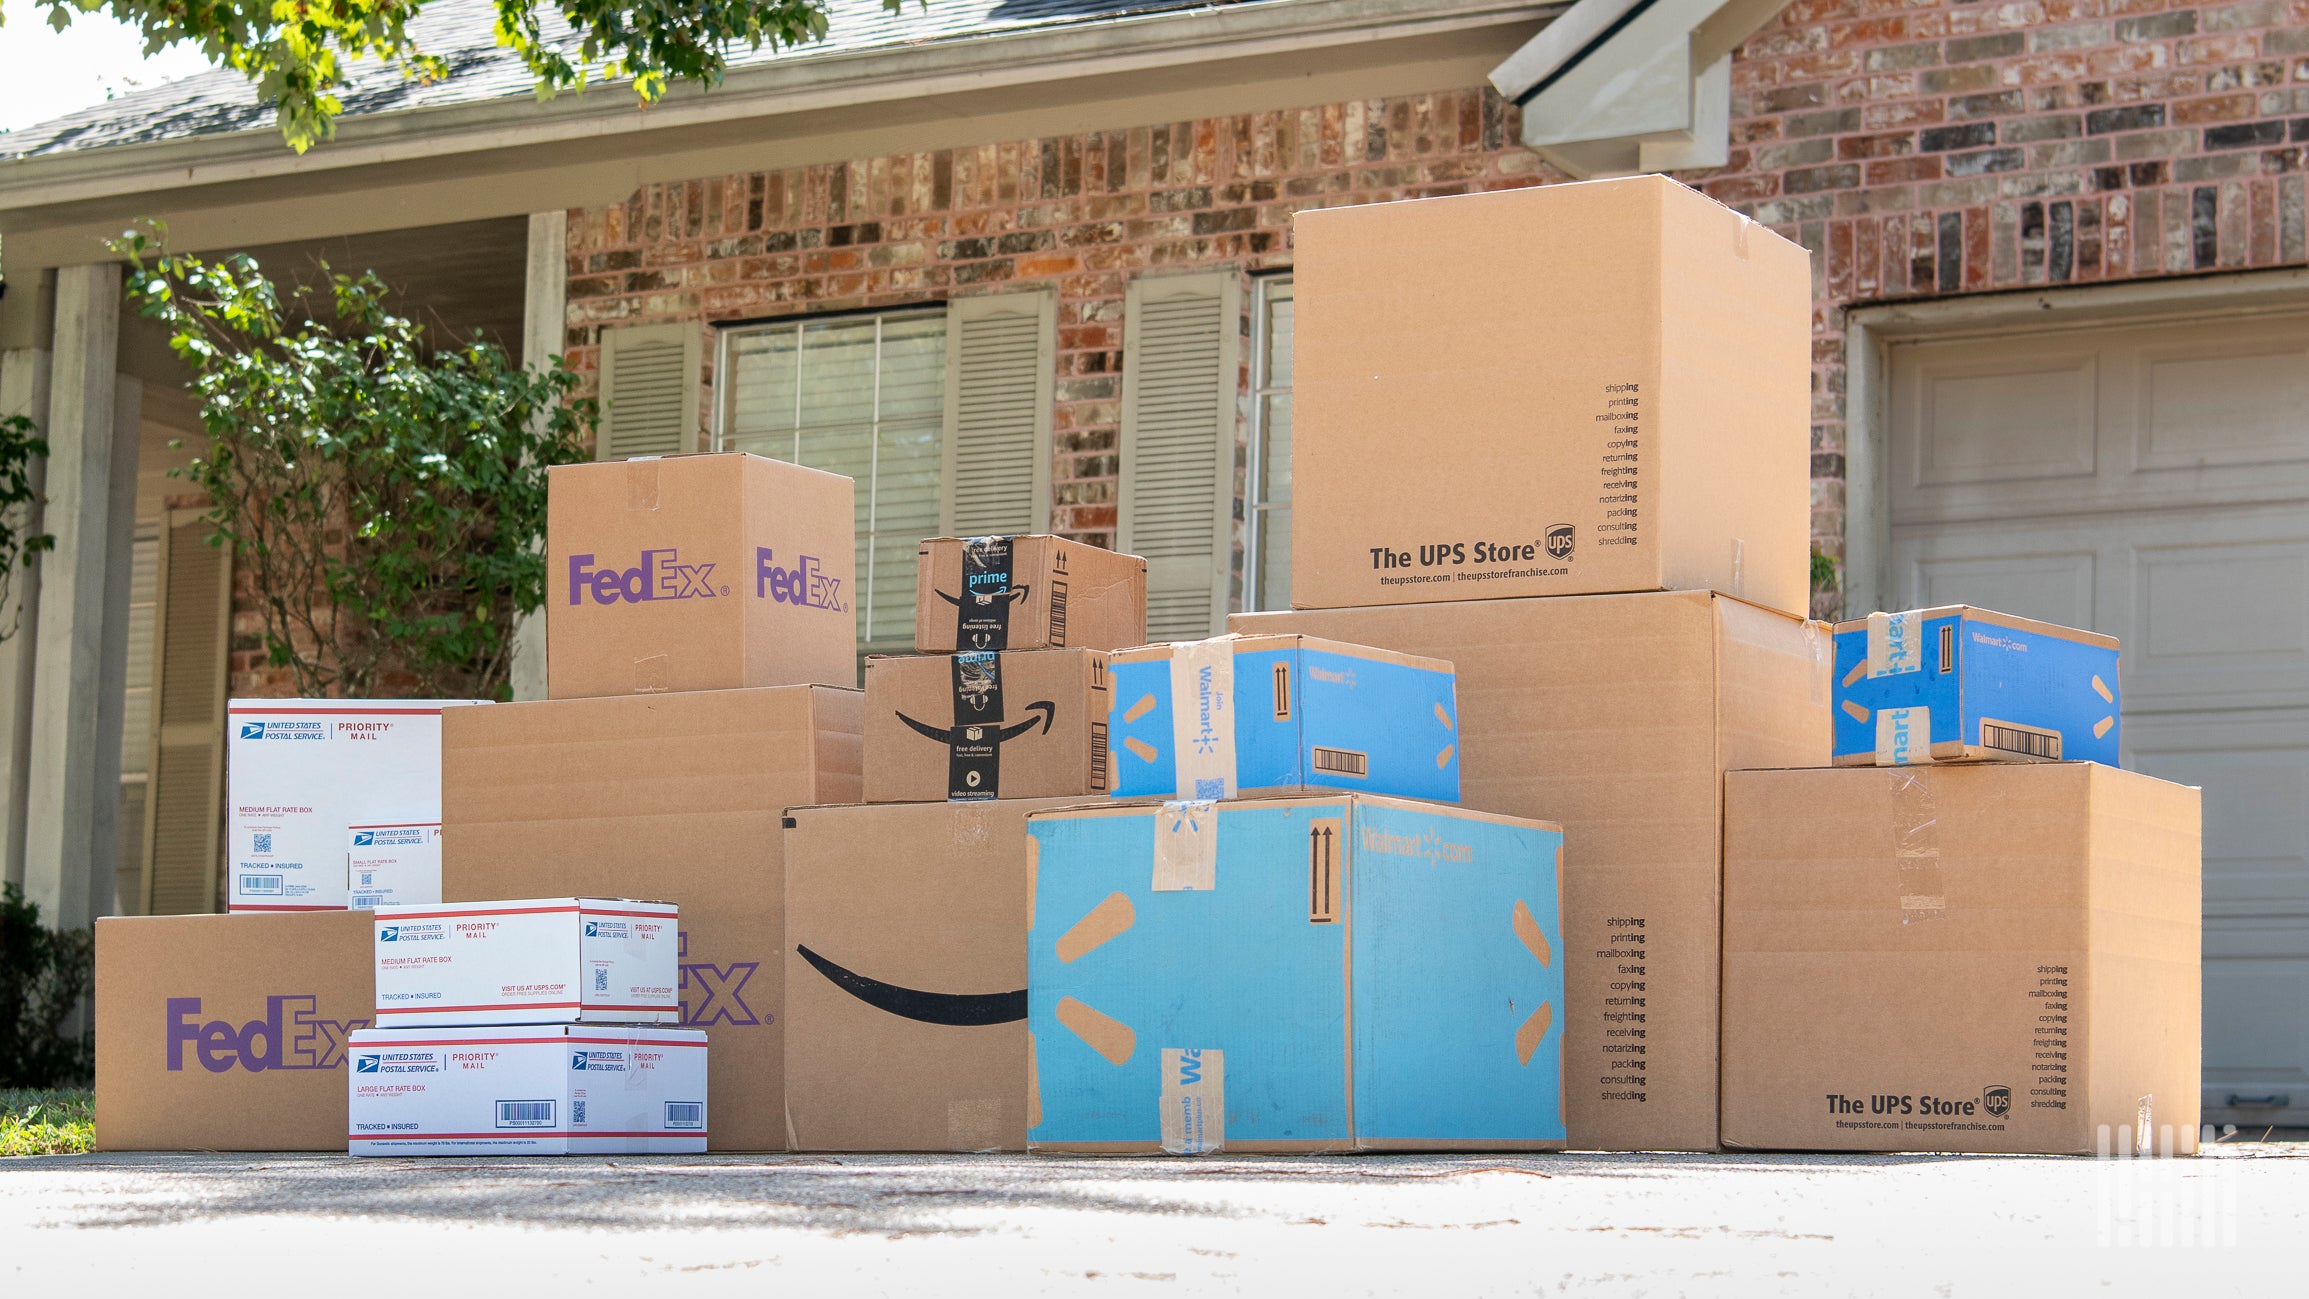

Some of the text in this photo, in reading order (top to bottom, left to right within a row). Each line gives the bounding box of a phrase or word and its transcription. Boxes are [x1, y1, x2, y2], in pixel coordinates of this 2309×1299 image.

[1605, 382, 1639, 394] shipping
[1608, 397, 1639, 408] printing
[1595, 411, 1639, 422] mailboxing
[1614, 425, 1638, 435] faxing
[1607, 439, 1638, 449] copying
[1602, 453, 1638, 462] returning
[1601, 466, 1638, 477] freighting
[1603, 480, 1638, 489] receiving
[1599, 494, 1638, 503] notarizing
[1607, 508, 1637, 519] packing
[1597, 522, 1637, 532] consulting
[1547, 532, 1573, 557] ups
[1598, 536, 1637, 546] shredding
[1370, 547, 1411, 569] The
[1420, 542, 1466, 566] UPS
[969, 571, 1008, 588] prime
[1380, 566, 1568, 586] theupsstore.com theupsstorefranchise.com
[1971, 631, 2002, 648] Walmart
[1309, 665, 1345, 685] Walmart
[1216, 691, 1224, 711] Join
[969, 745, 993, 753] delivery
[967, 790, 995, 798] streaming
[1361, 825, 1473, 865] Walmart com
[1607, 916, 1645, 928] shipping
[1610, 932, 1645, 944] printing
[1596, 948, 1645, 959] mailboxing
[381, 957, 406, 965] MEDIUM
[438, 955, 452, 963] BOX
[1618, 964, 1645, 975] faxing
[2037, 965, 2068, 975] shipping
[1610, 980, 1645, 992] copying
[2040, 978, 2068, 987] printing
[2028, 990, 2067, 999] mailboxing
[1605, 996, 1645, 1007] returning
[2045, 1002, 2067, 1011] faxing
[1603, 1012, 1646, 1023] freighting
[2039, 1014, 2067, 1023] copying
[166, 995, 371, 1073] FedEx
[1606, 1028, 1646, 1039] receiving
[2034, 1027, 2067, 1036] returning
[2033, 1039, 2067, 1048] freighting
[588, 1051, 606, 1059] UNITED
[1602, 1044, 1646, 1055] notarizing
[382, 1053, 409, 1061] UNITED
[2035, 1051, 2067, 1060] receiving
[587, 1063, 605, 1071] POSTAL
[1611, 1059, 1646, 1070] packing
[2031, 1063, 2067, 1073] notarizing
[1600, 1075, 1646, 1086] consulting
[2039, 1075, 2067, 1085] packing
[412, 1084, 426, 1092] BOX
[2030, 1088, 2066, 1097] consulting
[1601, 1091, 1646, 1102] shredding
[1826, 1094, 1864, 1114] The
[1871, 1094, 1913, 1115] UPS
[1986, 1094, 2009, 1112] ups
[2031, 1100, 2066, 1109] shredding
[1181, 1096, 1192, 1135] memb
[391, 1122, 418, 1130] INSURED
[1836, 1120, 2005, 1132] theupsstore.com theupsstorefranchise.com
